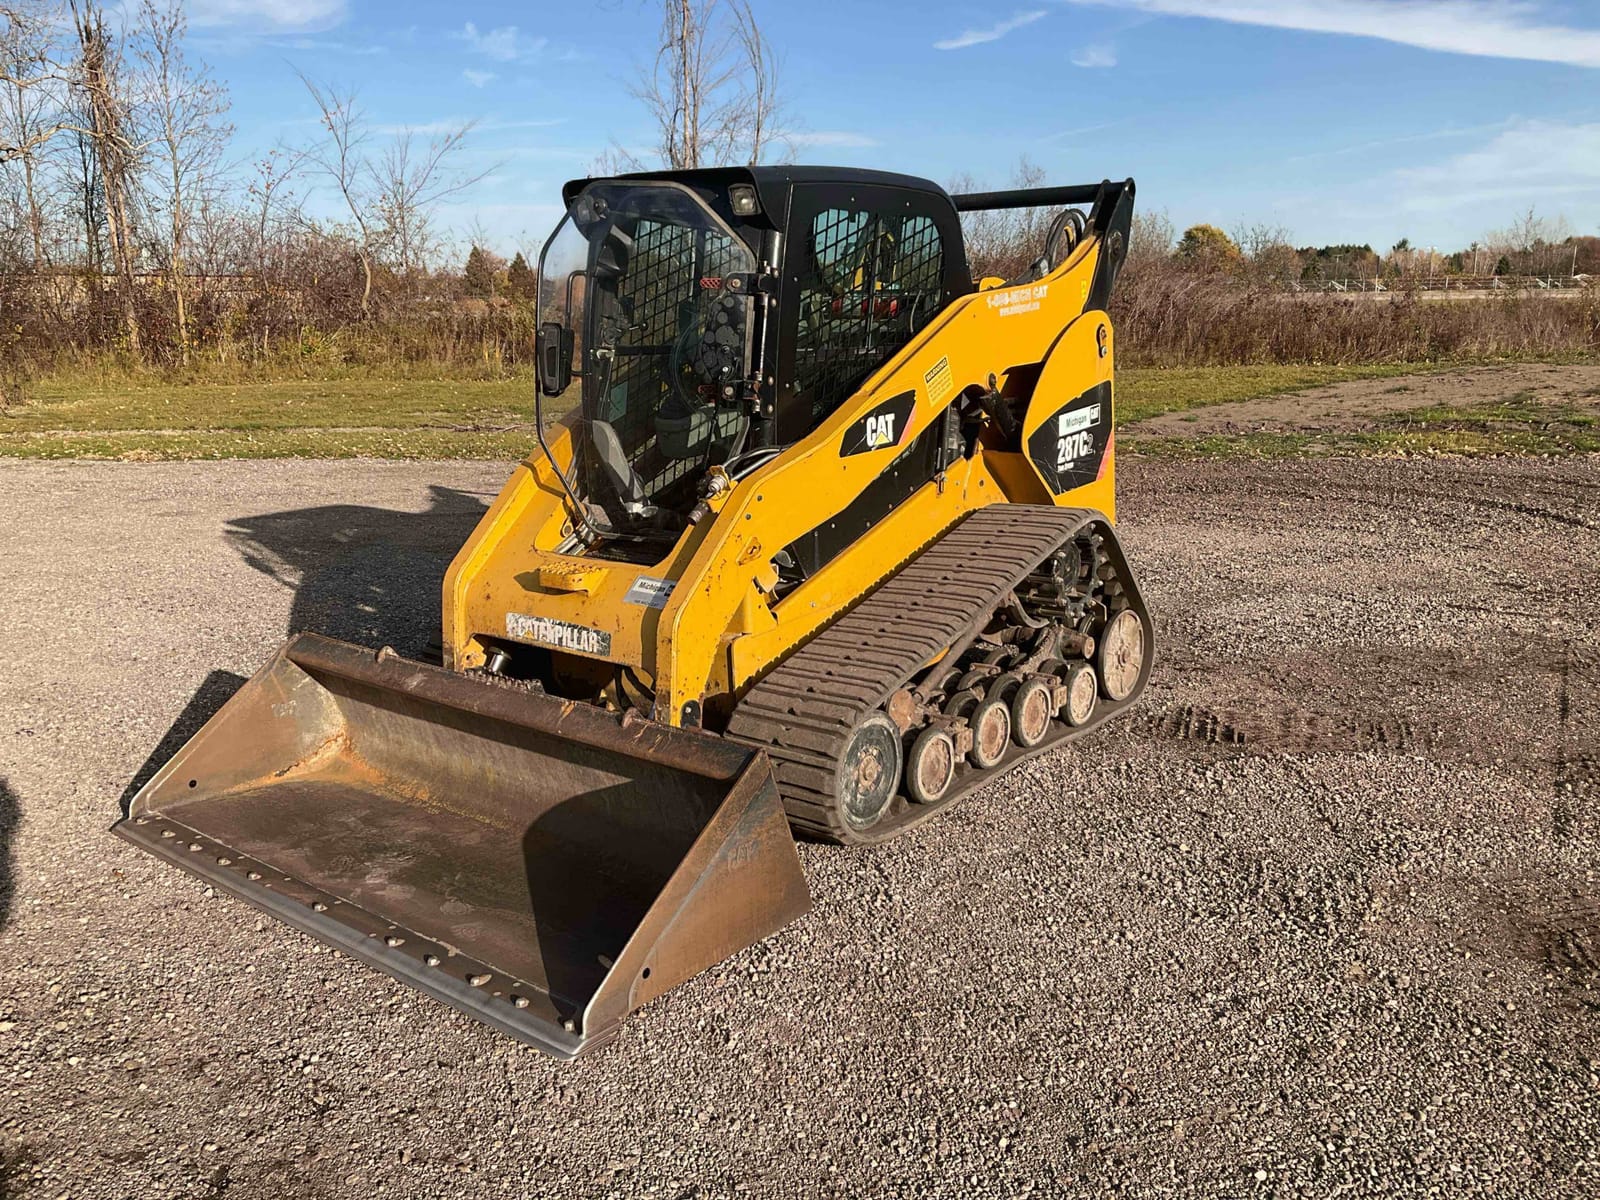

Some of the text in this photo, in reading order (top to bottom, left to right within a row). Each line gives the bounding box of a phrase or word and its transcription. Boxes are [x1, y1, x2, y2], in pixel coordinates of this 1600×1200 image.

[866, 413, 895, 447] CAT
[1066, 415, 1087, 427] Michigan
[518, 617, 598, 652] CATERPILLAR
